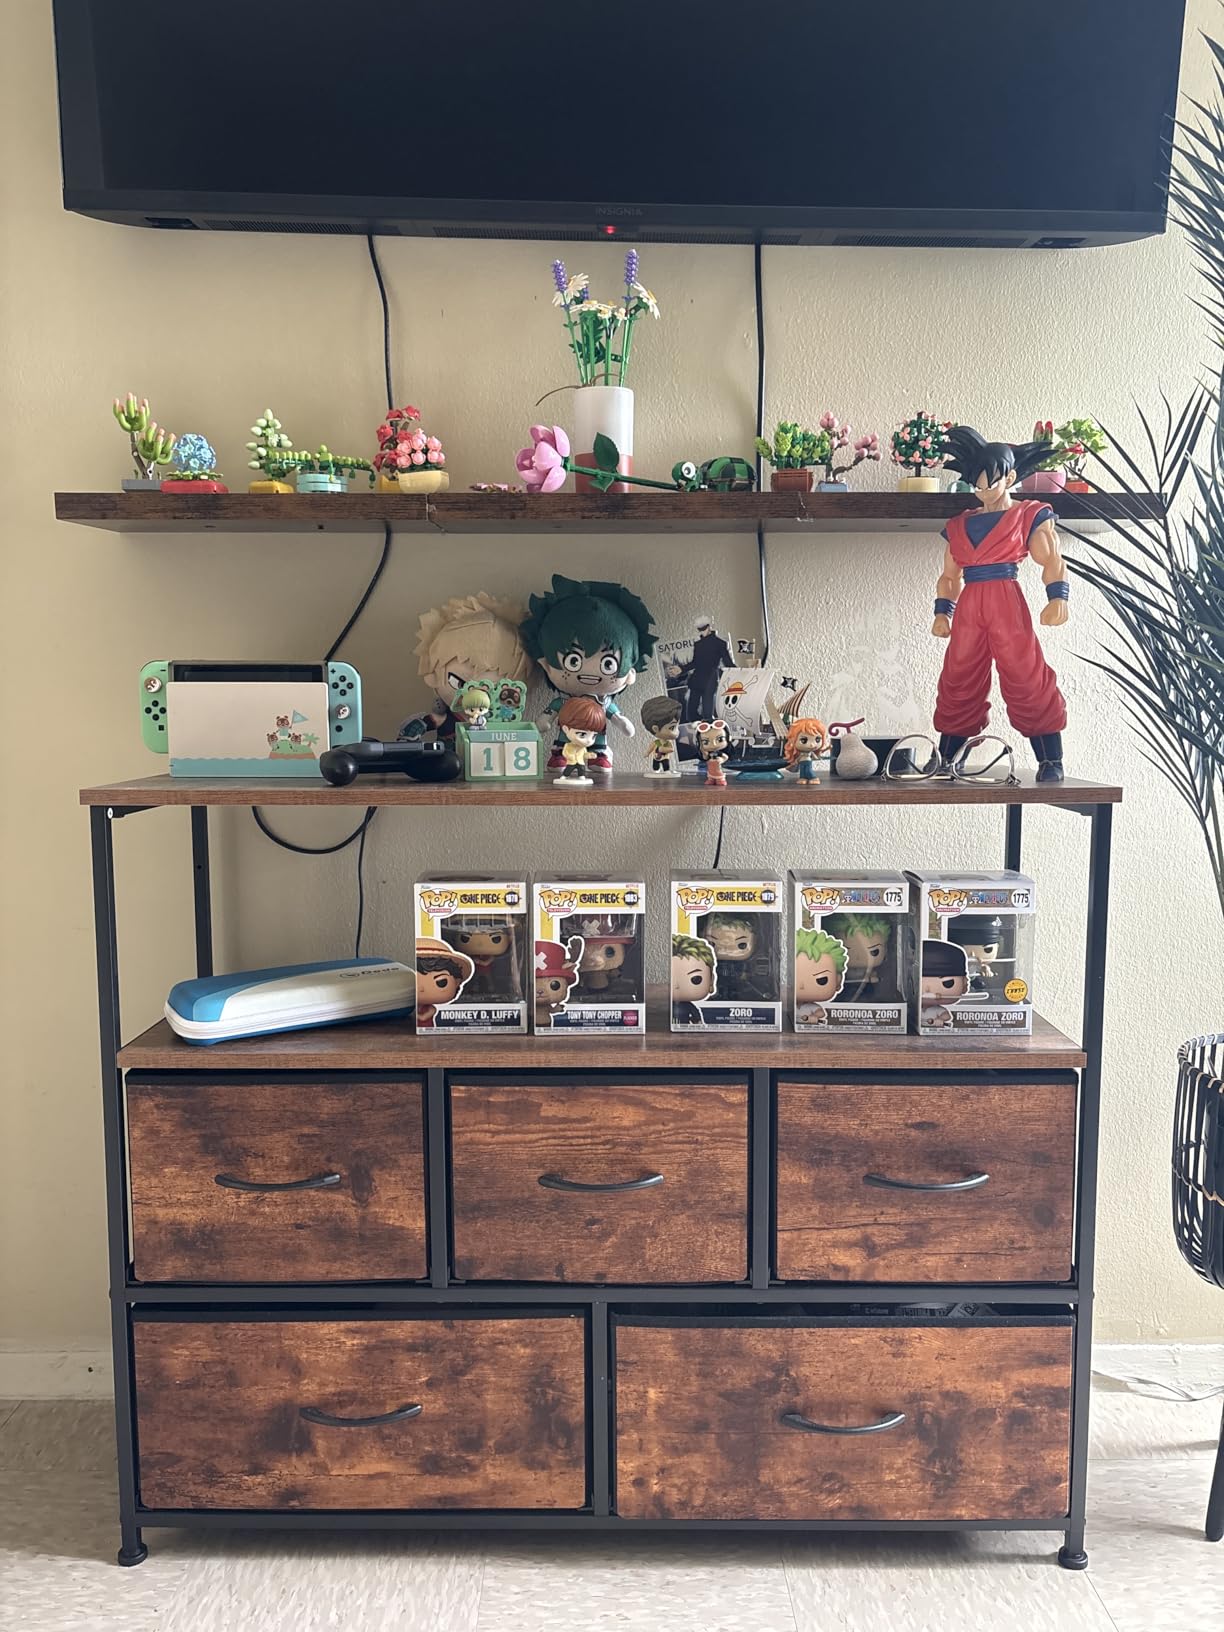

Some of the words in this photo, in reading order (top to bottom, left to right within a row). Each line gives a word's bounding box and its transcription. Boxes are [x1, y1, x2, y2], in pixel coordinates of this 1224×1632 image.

[595, 207, 643, 216] INSIGNIA
[491, 732, 517, 740] JUNE
[483, 747, 493, 771] 1
[514, 747, 531, 771] 8
[419, 890, 457, 908] POP!
[480, 893, 501, 904] PIECE
[539, 890, 577, 908] POP!
[599, 893, 620, 904] PIECE
[676, 888, 715, 906] POP!
[736, 891, 757, 902] PIECE
[800, 887, 840, 907] POP!
[885, 891, 902, 902] 1775
[928, 889, 967, 907] POP!
[1013, 893, 1029, 904] 1775
[440, 1010, 479, 1020] MONKEY
[480, 1010, 490, 1019] D.
[492, 1010, 519, 1019] LUFFY
[567, 1011, 581, 1020] TONY
[582, 1011, 596, 1020] TONY
[597, 1010, 622, 1020] CHOPPER
[729, 1008, 753, 1017] ZORO
[831, 1009, 873, 1019] RORONOA
[876, 1009, 899, 1019] ZORO
[956, 1012, 998, 1021] RORONOA
[1001, 1012, 1024, 1021] ZORO
